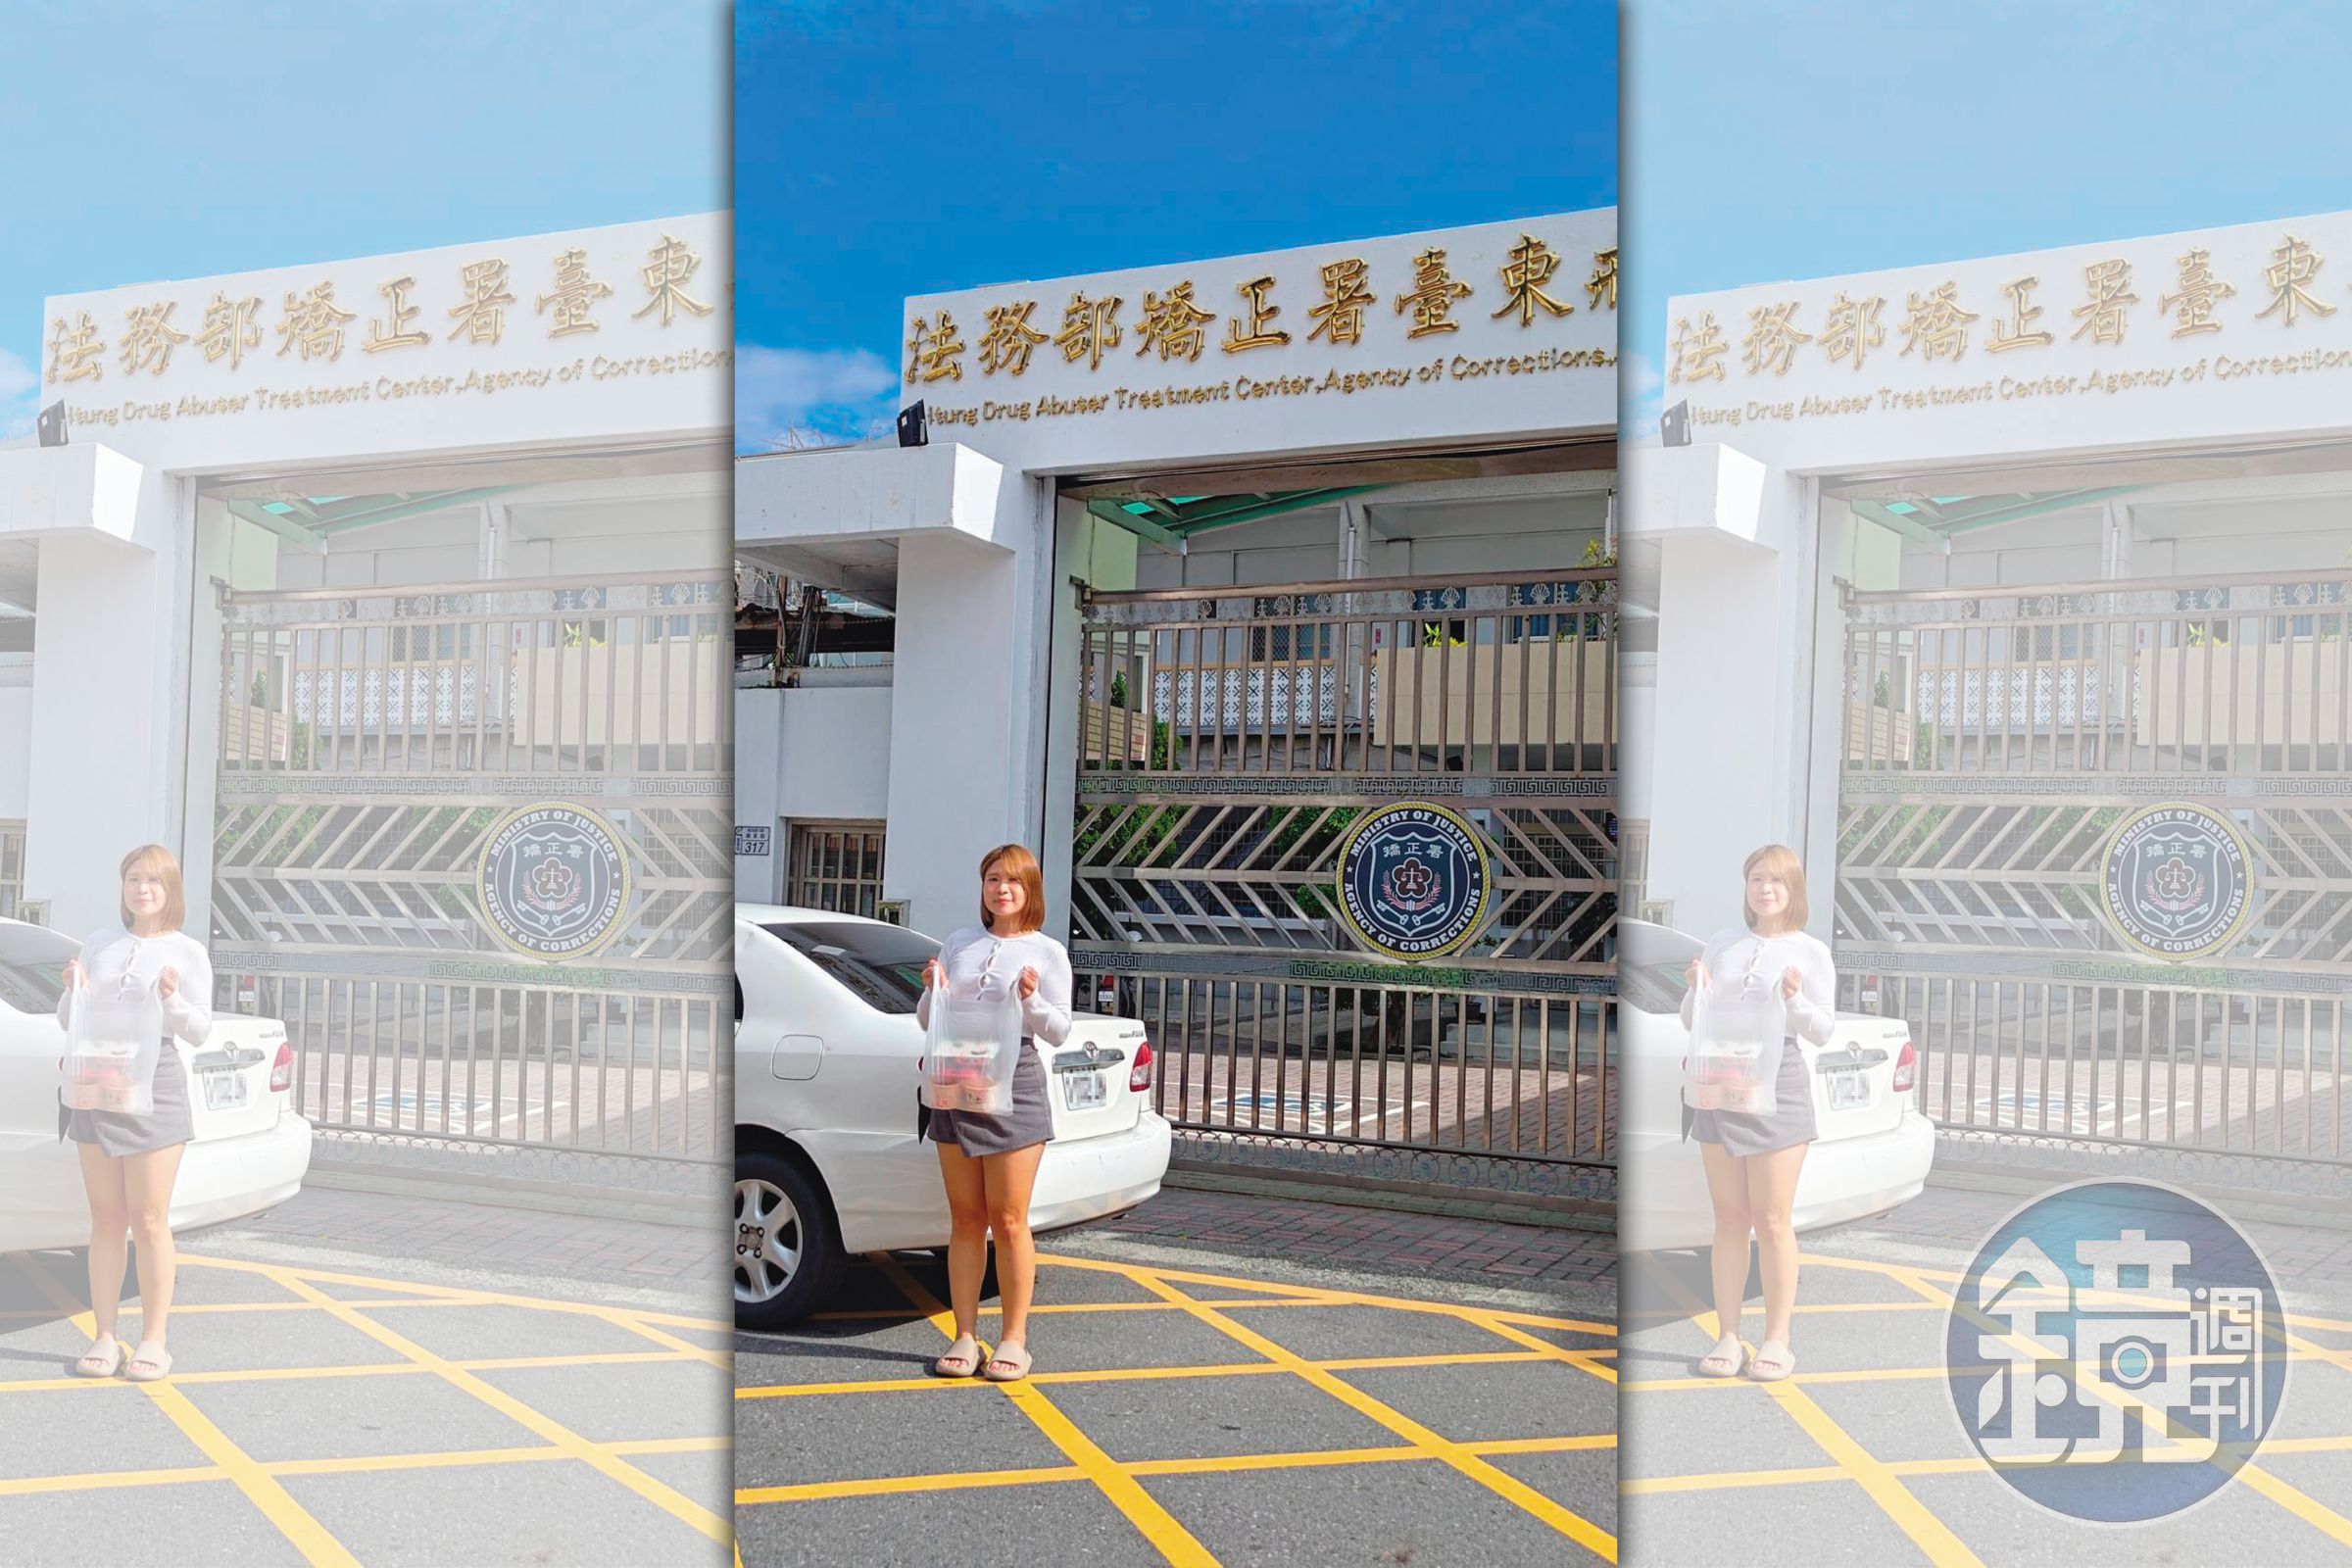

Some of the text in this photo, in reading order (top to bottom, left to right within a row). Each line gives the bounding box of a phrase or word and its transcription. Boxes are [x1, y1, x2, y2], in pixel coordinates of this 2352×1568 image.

[45, 233, 735, 384] 法務部矯正署臺東
[1668, 233, 2352, 384] 法務部矯正署臺東
[123, 400, 172, 421] Drug
[176, 394, 250, 416] Abuser
[255, 380, 370, 410] Treatment
[558, 358, 584, 382] of
[592, 347, 735, 380] Correction
[983, 400, 1031, 421] Drug
[1036, 394, 1109, 416] Abuser
[1114, 380, 1230, 410] Treatment
[1417, 358, 1444, 382] of
[1746, 400, 1794, 421] Drug
[1799, 394, 1873, 416] Abuser
[1878, 380, 1993, 410] Treatment
[2180, 358, 2207, 382] of
[491, 810, 618, 862] MINISTRY OF JUSTICE
[745, 841, 764, 853] 317
[1350, 810, 1478, 862] MINISTRY OF JUSTICE
[2114, 810, 2241, 862] MINISTRY OF JUSTICE
[485, 883, 621, 952] AGENCY OF CORRECTIONS
[1345, 883, 1481, 952] AGENCY OF CORRECTIONS
[2108, 883, 2244, 952] AGENCY OF CORRECTIONS
